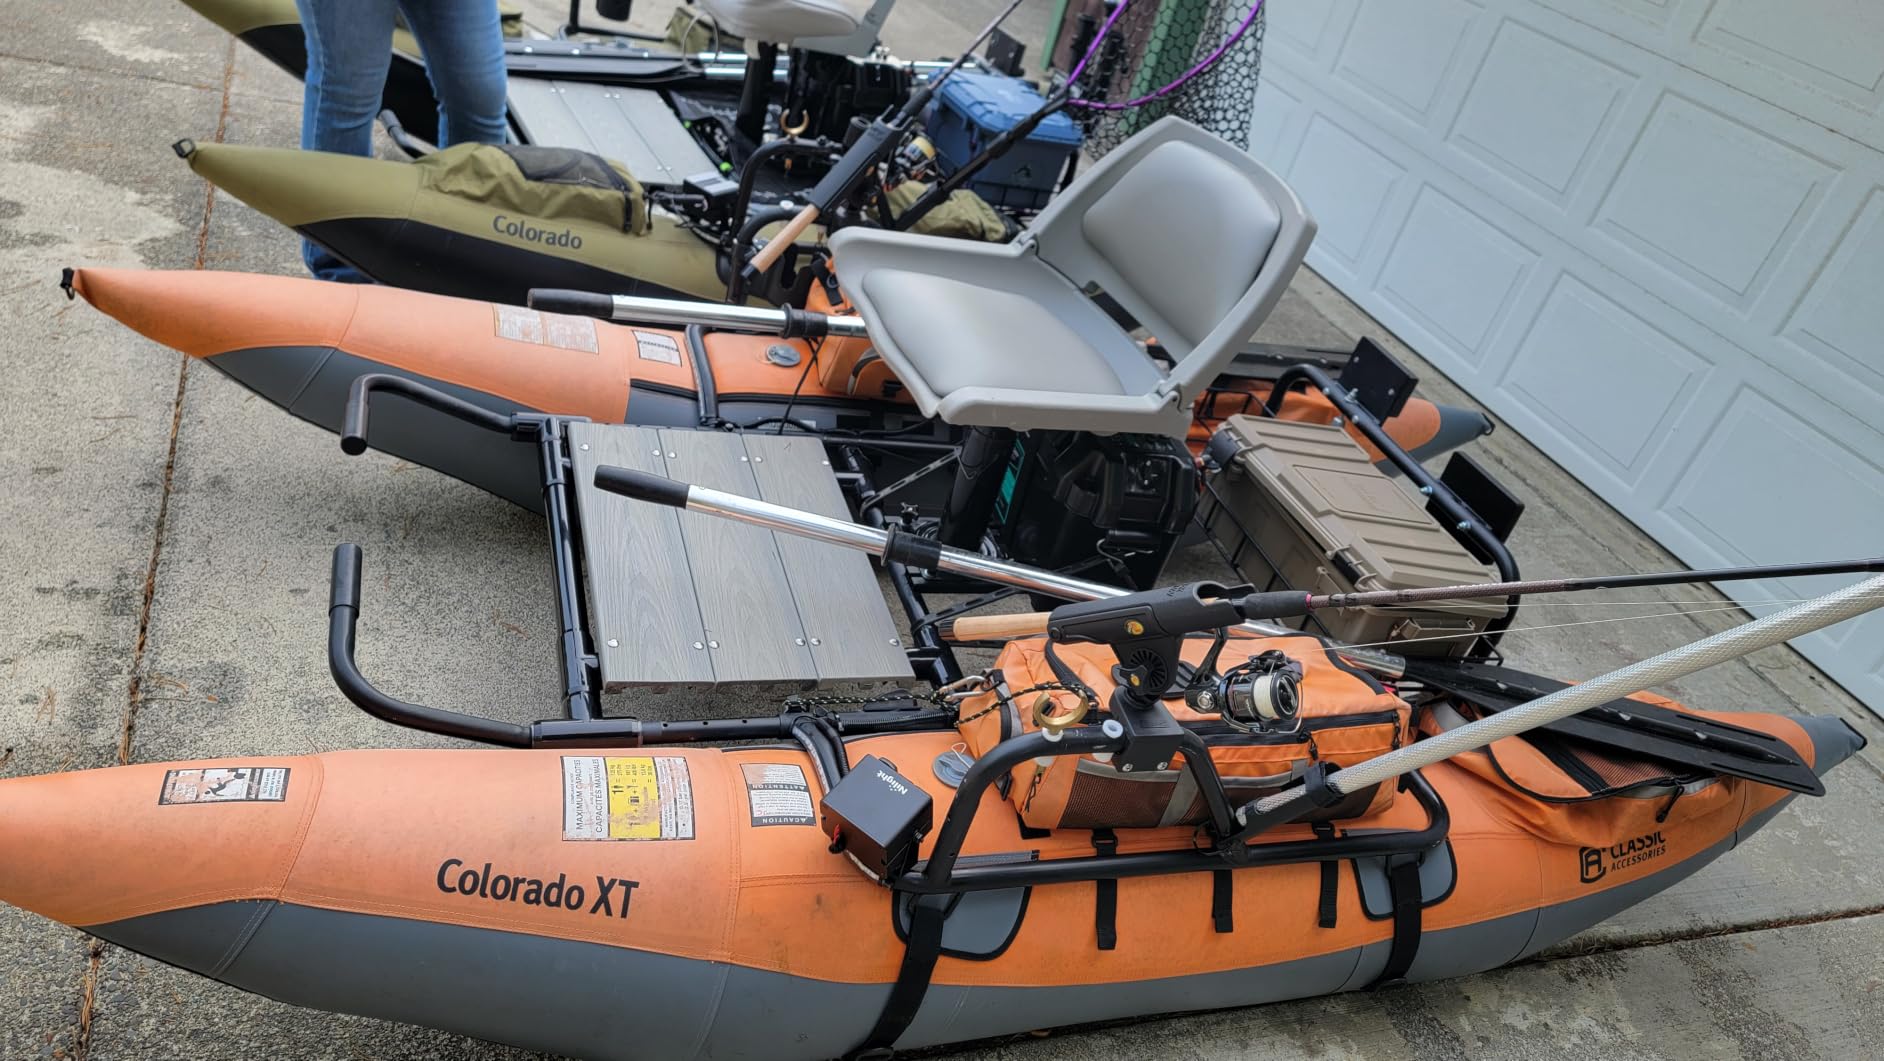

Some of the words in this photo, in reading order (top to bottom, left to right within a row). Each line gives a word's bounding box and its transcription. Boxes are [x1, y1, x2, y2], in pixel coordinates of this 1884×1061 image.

[492, 215, 582, 249] Colorado
[876, 769, 908, 795] Nilight
[575, 790, 584, 830] MAXIMUM
[1610, 845, 1666, 872] ACCESSORIES
[437, 858, 585, 910] Colorado
[589, 875, 640, 919] XT
